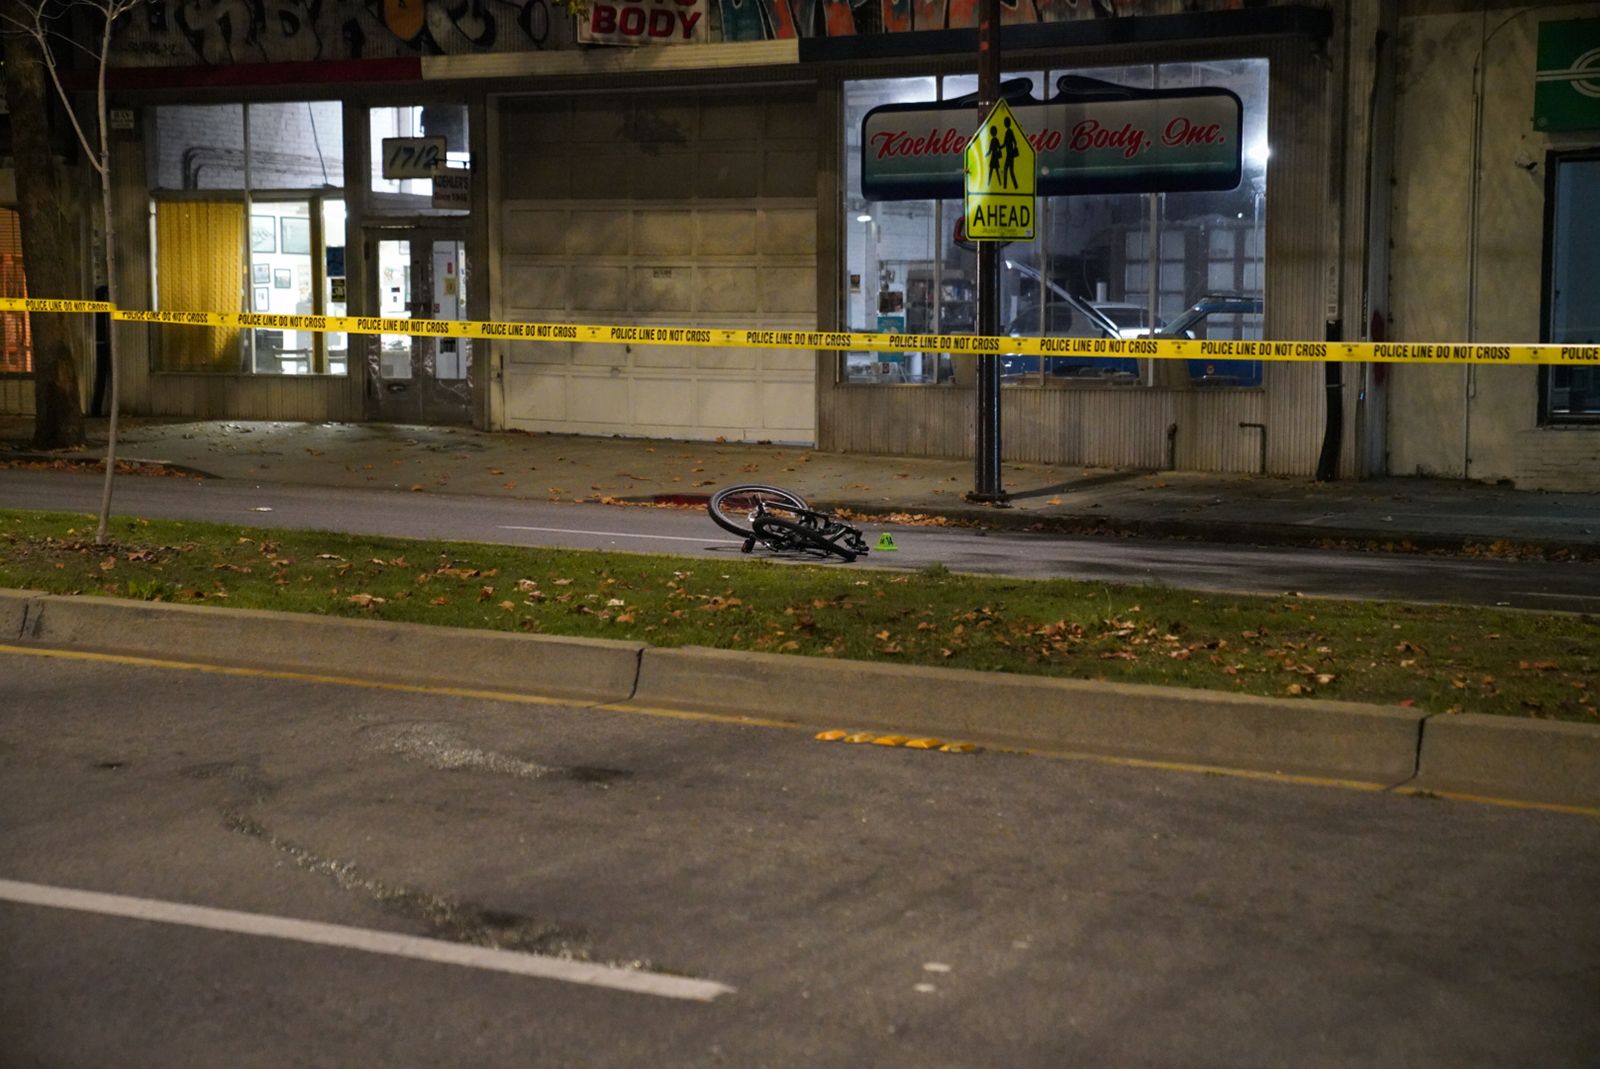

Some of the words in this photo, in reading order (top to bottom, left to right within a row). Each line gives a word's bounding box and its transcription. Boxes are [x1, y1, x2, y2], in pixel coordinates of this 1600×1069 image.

[591, 6, 702, 40] BODY
[870, 127, 974, 161] Koehle
[1069, 119, 1152, 160] Body,
[1161, 117, 1226, 146] Inc.
[389, 144, 439, 169] 1712
[973, 204, 1031, 228] AHEAD
[25, 300, 49, 311] POLICE
[50, 300, 63, 311] LINE
[64, 301, 73, 311] DO
[74, 301, 88, 311] NOT
[88, 301, 108, 311] CROSS
[122, 311, 146, 321] POLICE
[147, 312, 161, 322] LINE
[162, 312, 171, 322] DO
[172, 312, 186, 322] NOT
[186, 312, 208, 323] CROSS
[238, 313, 261, 326] POLICE
[263, 314, 277, 326] LINE
[278, 315, 288, 327] DO
[290, 316, 302, 328] NOT
[304, 316, 326, 329] CROSS
[357, 318, 382, 331] POLICE
[383, 319, 398, 331] LINE
[400, 320, 409, 332] DO
[411, 320, 424, 333] NOT
[425, 321, 449, 334] CROSS
[481, 323, 506, 335] POLICE
[508, 324, 524, 336] LINE
[525, 324, 535, 337] DO
[537, 325, 551, 337] NOT
[552, 325, 577, 338] CROSS
[610, 327, 637, 340] POLICE
[639, 328, 655, 341] LINE
[657, 328, 667, 341] DO
[669, 329, 684, 342] NOT
[685, 330, 711, 342] CROSS
[746, 331, 774, 345] POLICE
[775, 331, 792, 345] LINE
[794, 332, 806, 346] DO
[807, 332, 824, 346] NOT
[825, 333, 851, 347] CROSS
[889, 335, 918, 348] POLICE
[920, 335, 938, 349] LINE
[940, 336, 951, 349] DO
[953, 336, 970, 350] NOT
[972, 337, 1000, 351] CROSS
[1040, 338, 1070, 352] POLICE
[1072, 339, 1092, 353] LINE
[1094, 339, 1106, 353] DO
[1108, 340, 1126, 354] NOT
[1128, 340, 1158, 354] CROSS
[1200, 341, 1233, 355] POLICE
[1236, 342, 1256, 356] LINE
[1258, 342, 1272, 356] DO
[1274, 342, 1294, 357] NOT
[1296, 342, 1327, 357] CROSS
[1374, 344, 1409, 358] POLICE
[1411, 344, 1434, 359] LINE
[1436, 345, 1450, 359] DO
[1453, 345, 1474, 359] NOT
[1476, 345, 1510, 360] CROSS
[1561, 346, 1599, 360] POLICE
